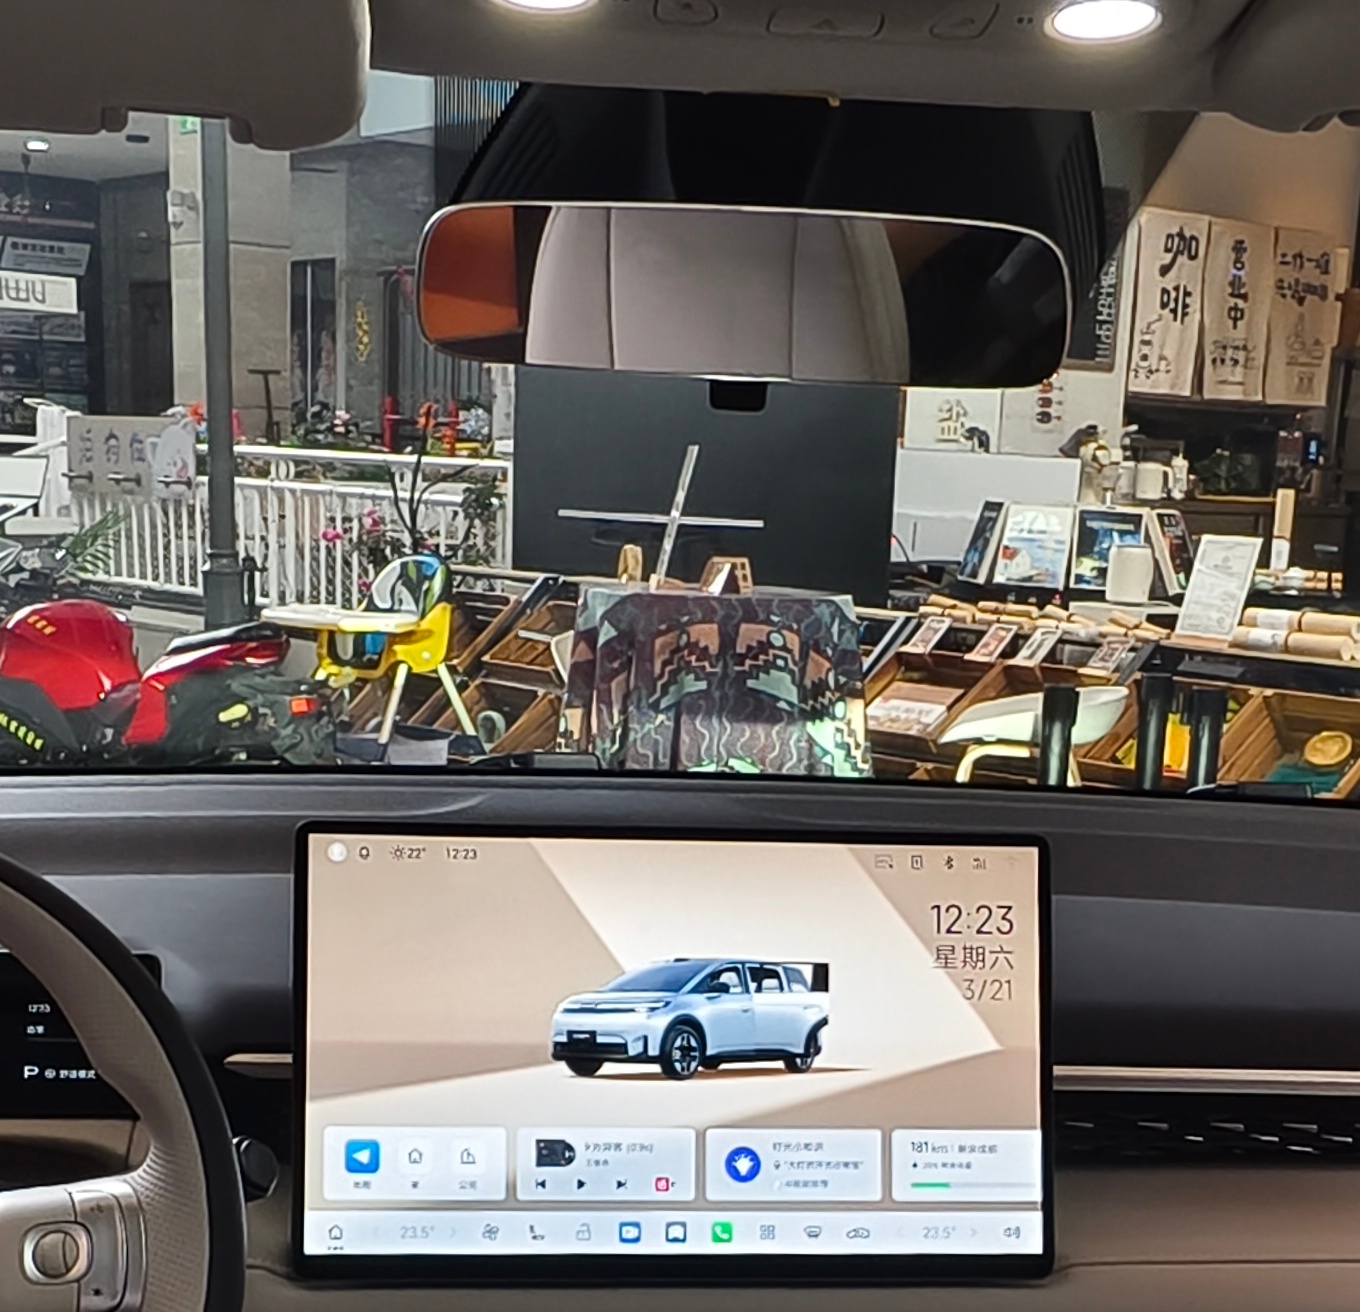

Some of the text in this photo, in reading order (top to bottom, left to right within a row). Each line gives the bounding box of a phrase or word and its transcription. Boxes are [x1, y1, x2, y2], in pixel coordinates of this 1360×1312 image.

[1159, 226, 1199, 325] 咖啡
[446, 846, 477, 860] 12:23
[930, 904, 1014, 935] 12:23
[933, 944, 1015, 970] 星期六
[962, 978, 1013, 1001] 3/21
[24, 1065, 39, 1079] P
